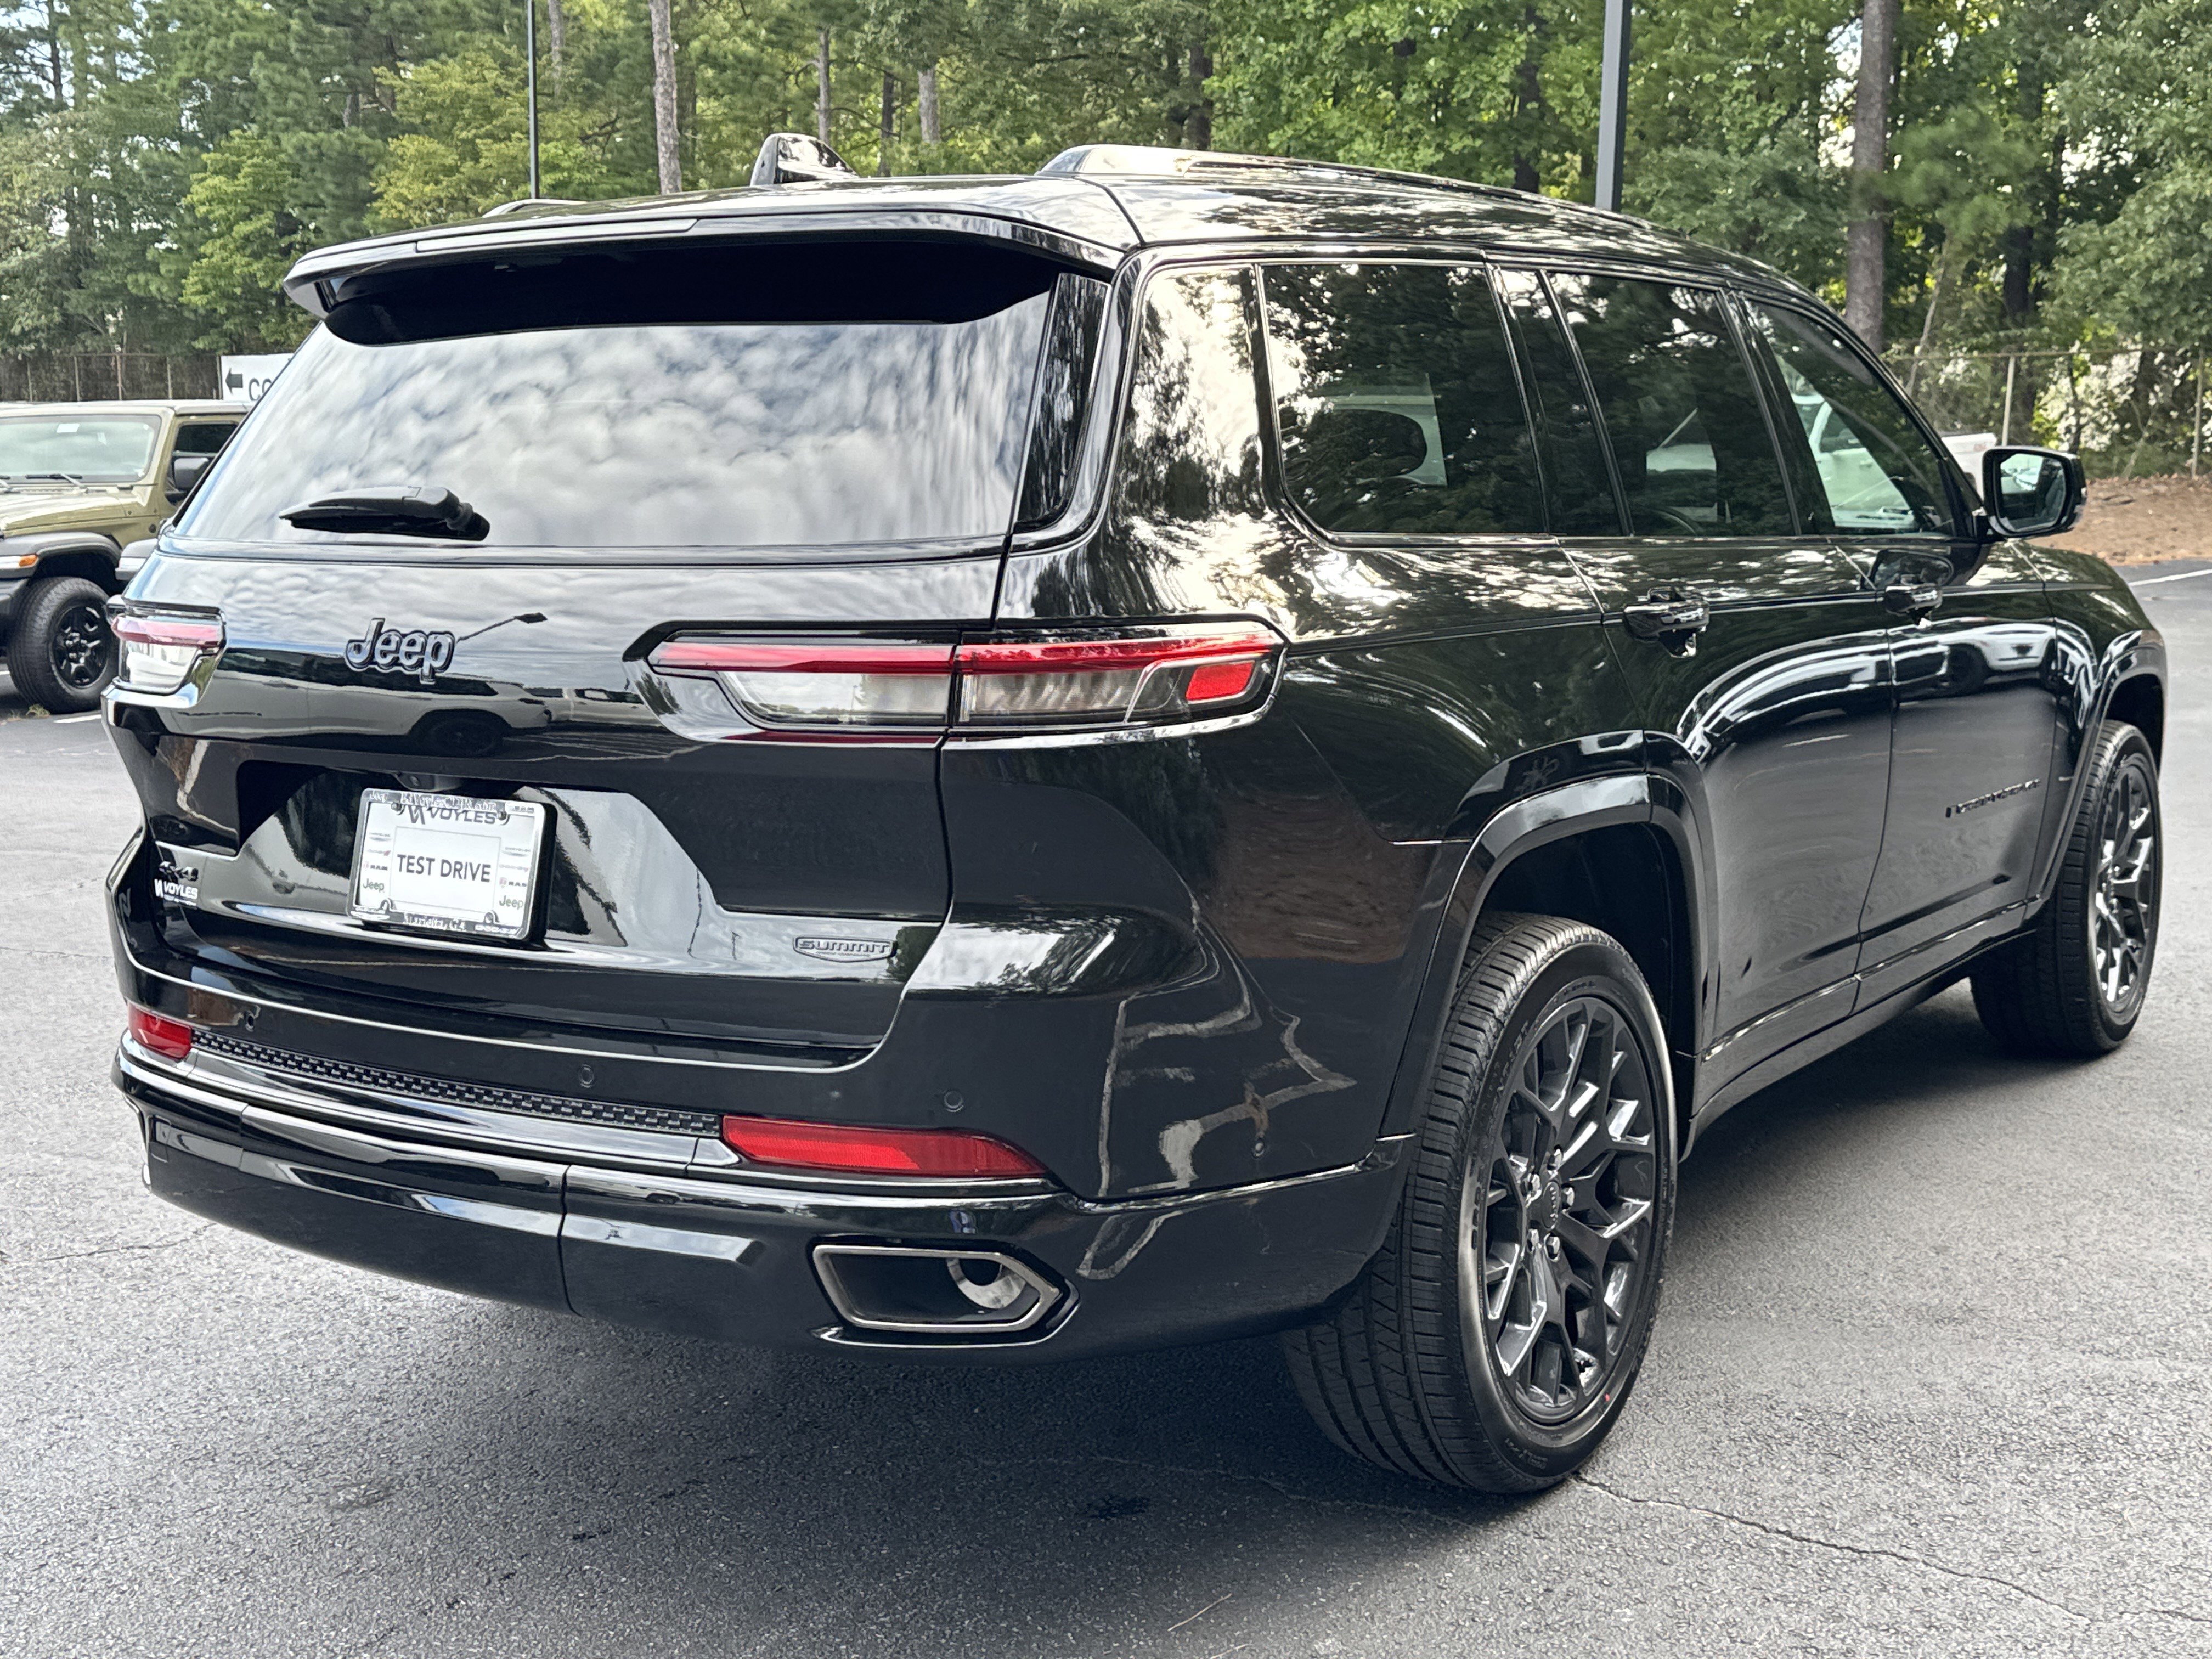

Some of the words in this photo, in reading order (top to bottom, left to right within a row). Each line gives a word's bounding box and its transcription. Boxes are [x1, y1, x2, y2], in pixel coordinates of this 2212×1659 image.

[345, 617, 455, 684] Jeep
[430, 806, 496, 825] VOYLES
[397, 854, 436, 876] TEST
[440, 859, 491, 883] DRIVE
[163, 881, 198, 900] VOYLES
[363, 877, 385, 893] Jeep
[499, 895, 524, 911] Jeep
[799, 940, 890, 953] SUMMIT
